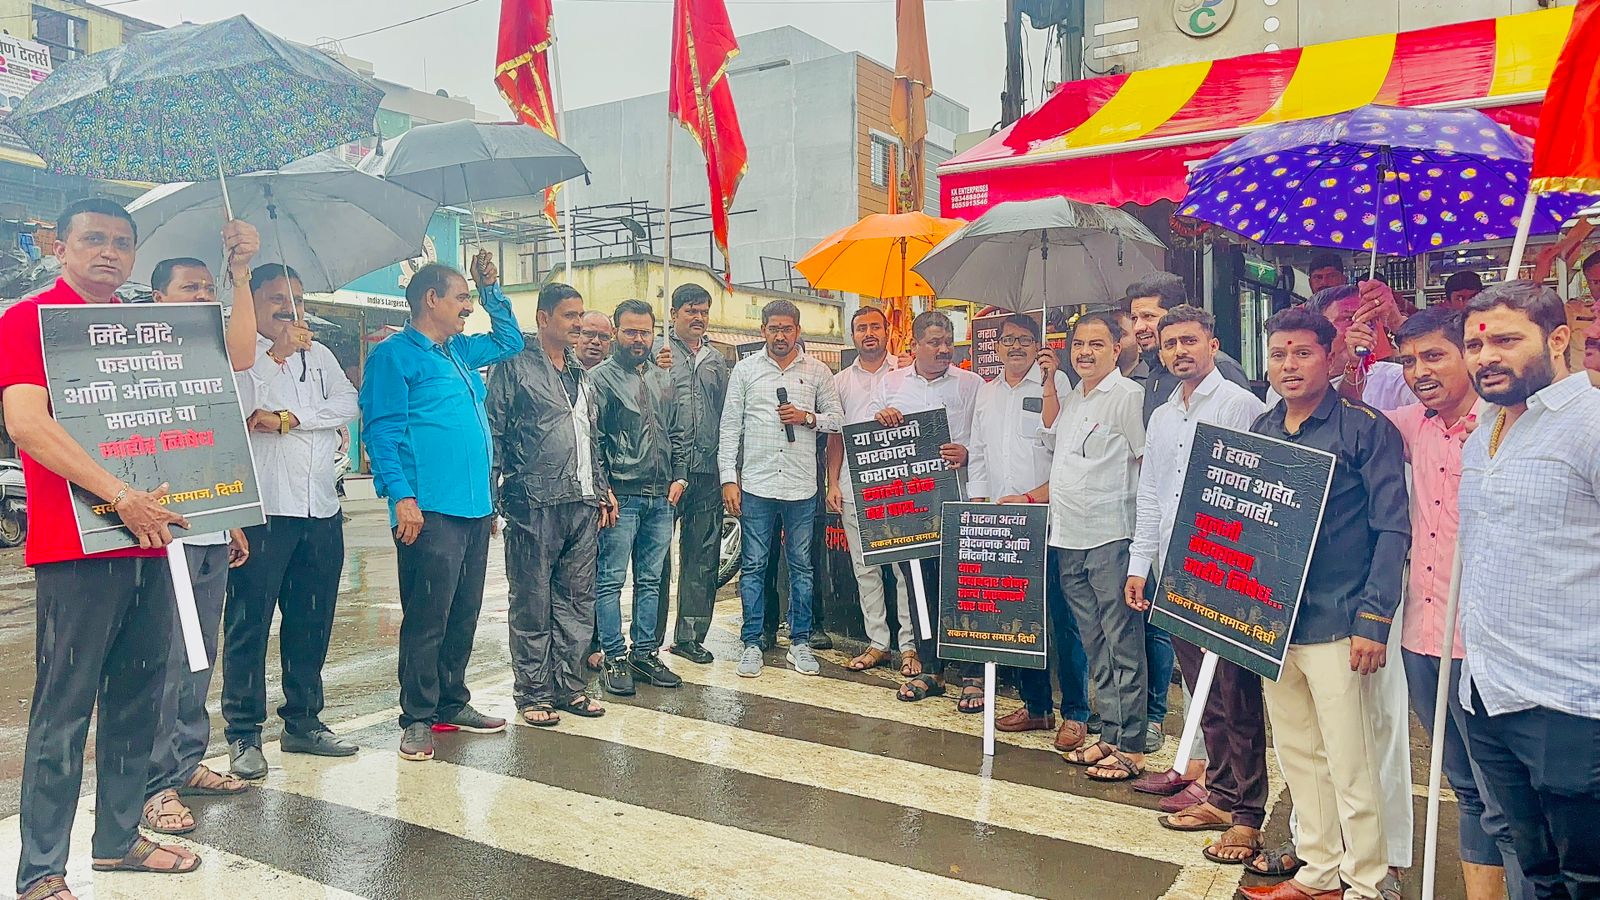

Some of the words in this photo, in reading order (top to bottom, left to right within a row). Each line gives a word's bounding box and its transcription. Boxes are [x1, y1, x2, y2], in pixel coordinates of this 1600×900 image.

[977, 328, 998, 339] मराठ
[96, 351, 183, 374] फडणवीस
[63, 382, 117, 405] आणि
[122, 378, 178, 400] अजित
[180, 377, 223, 396] पवार
[104, 406, 173, 430] सरकार
[175, 404, 197, 422] चा
[852, 432, 871, 446] या
[872, 420, 920, 447] जुलमी
[855, 440, 917, 465] सरकारचं
[1212, 439, 1225, 460] ते
[1225, 446, 1262, 469] हक्क
[858, 460, 909, 483] करायचं
[173, 488, 213, 502] समाज,
[215, 480, 243, 497] दिघी
[1207, 465, 1252, 492] मागत
[1252, 479, 1301, 509] आहेत..
[960, 511, 971, 524] ही
[971, 514, 997, 525] घटना
[999, 512, 1027, 526] अत्यंत
[1201, 486, 1236, 510] भीक
[1236, 498, 1279, 527] नाही..
[870, 540, 892, 548] सकल
[893, 535, 914, 545] मराठा
[915, 531, 940, 541] समाज,
[1194, 512, 1243, 543] जुलमी
[959, 536, 1003, 549] खेदजनक
[1005, 538, 1031, 551] आणि
[998, 550, 1023, 564] आहे..
[1167, 591, 1193, 611] सकल
[1193, 602, 1220, 622] मराठा
[1252, 624, 1277, 646] दिघी
[947, 629, 968, 638] सकल
[969, 631, 990, 640] मराठा
[1017, 632, 1036, 644] दिघी
